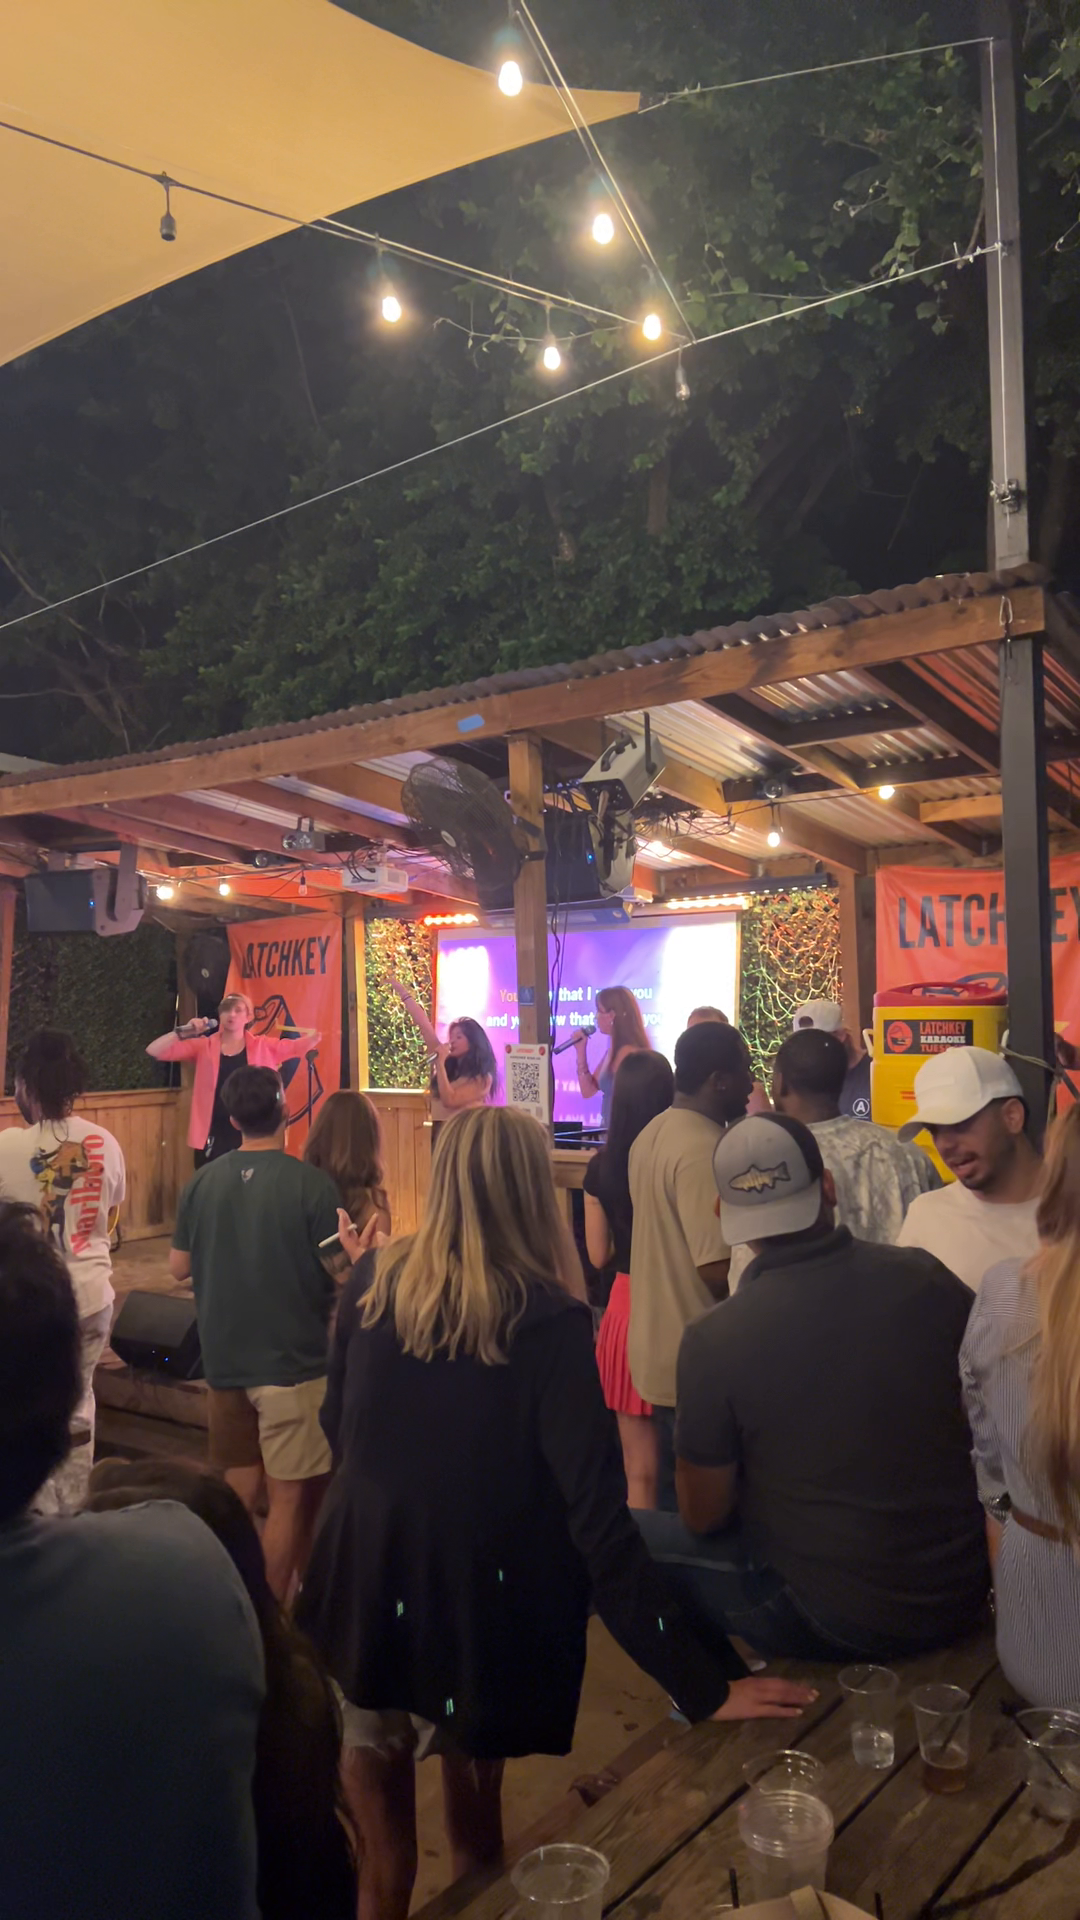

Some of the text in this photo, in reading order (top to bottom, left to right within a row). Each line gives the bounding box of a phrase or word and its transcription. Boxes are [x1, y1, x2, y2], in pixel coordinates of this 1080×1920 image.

[558, 987, 583, 1001] that
[587, 986, 592, 1001] I
[486, 1014, 508, 1027] and
[569, 1011, 595, 1026] that
[920, 1021, 966, 1034] LATCHKEY
[920, 1035, 966, 1044] KARAOKE
[69, 1134, 105, 1256] Marlboro
